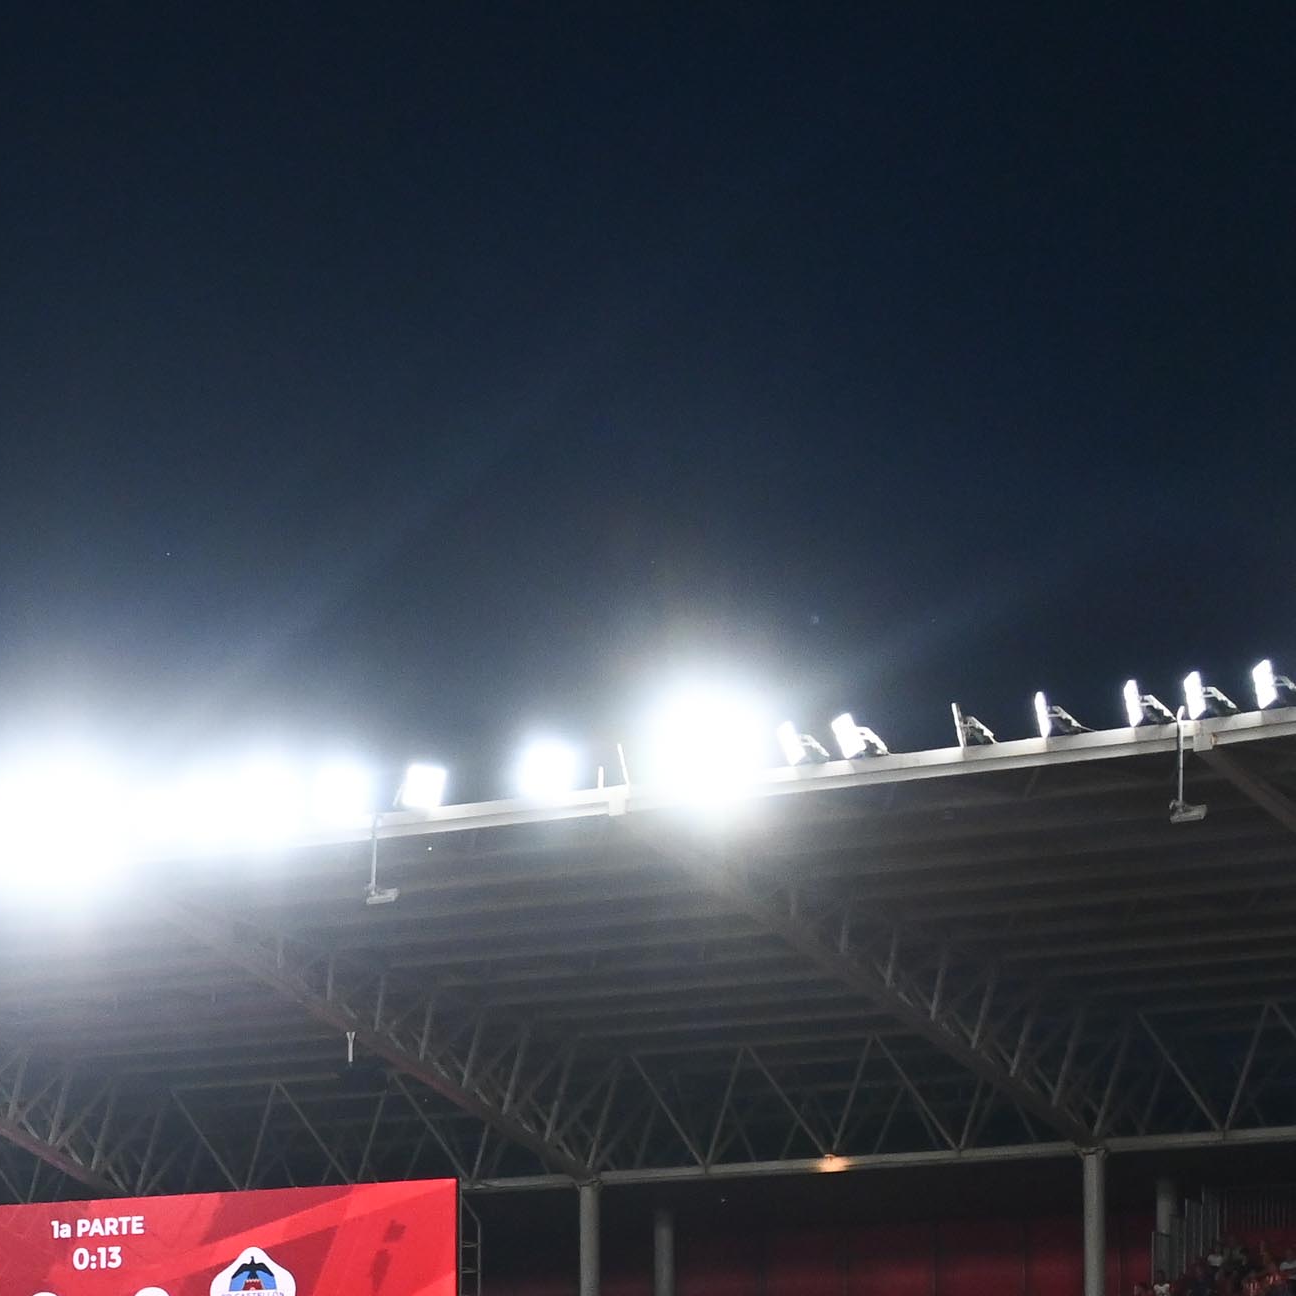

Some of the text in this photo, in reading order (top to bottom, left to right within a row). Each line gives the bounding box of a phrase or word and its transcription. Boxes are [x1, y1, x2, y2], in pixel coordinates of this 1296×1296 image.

[51, 1216, 144, 1238] 1a PARTE
[73, 1246, 122, 1270] 0:13
